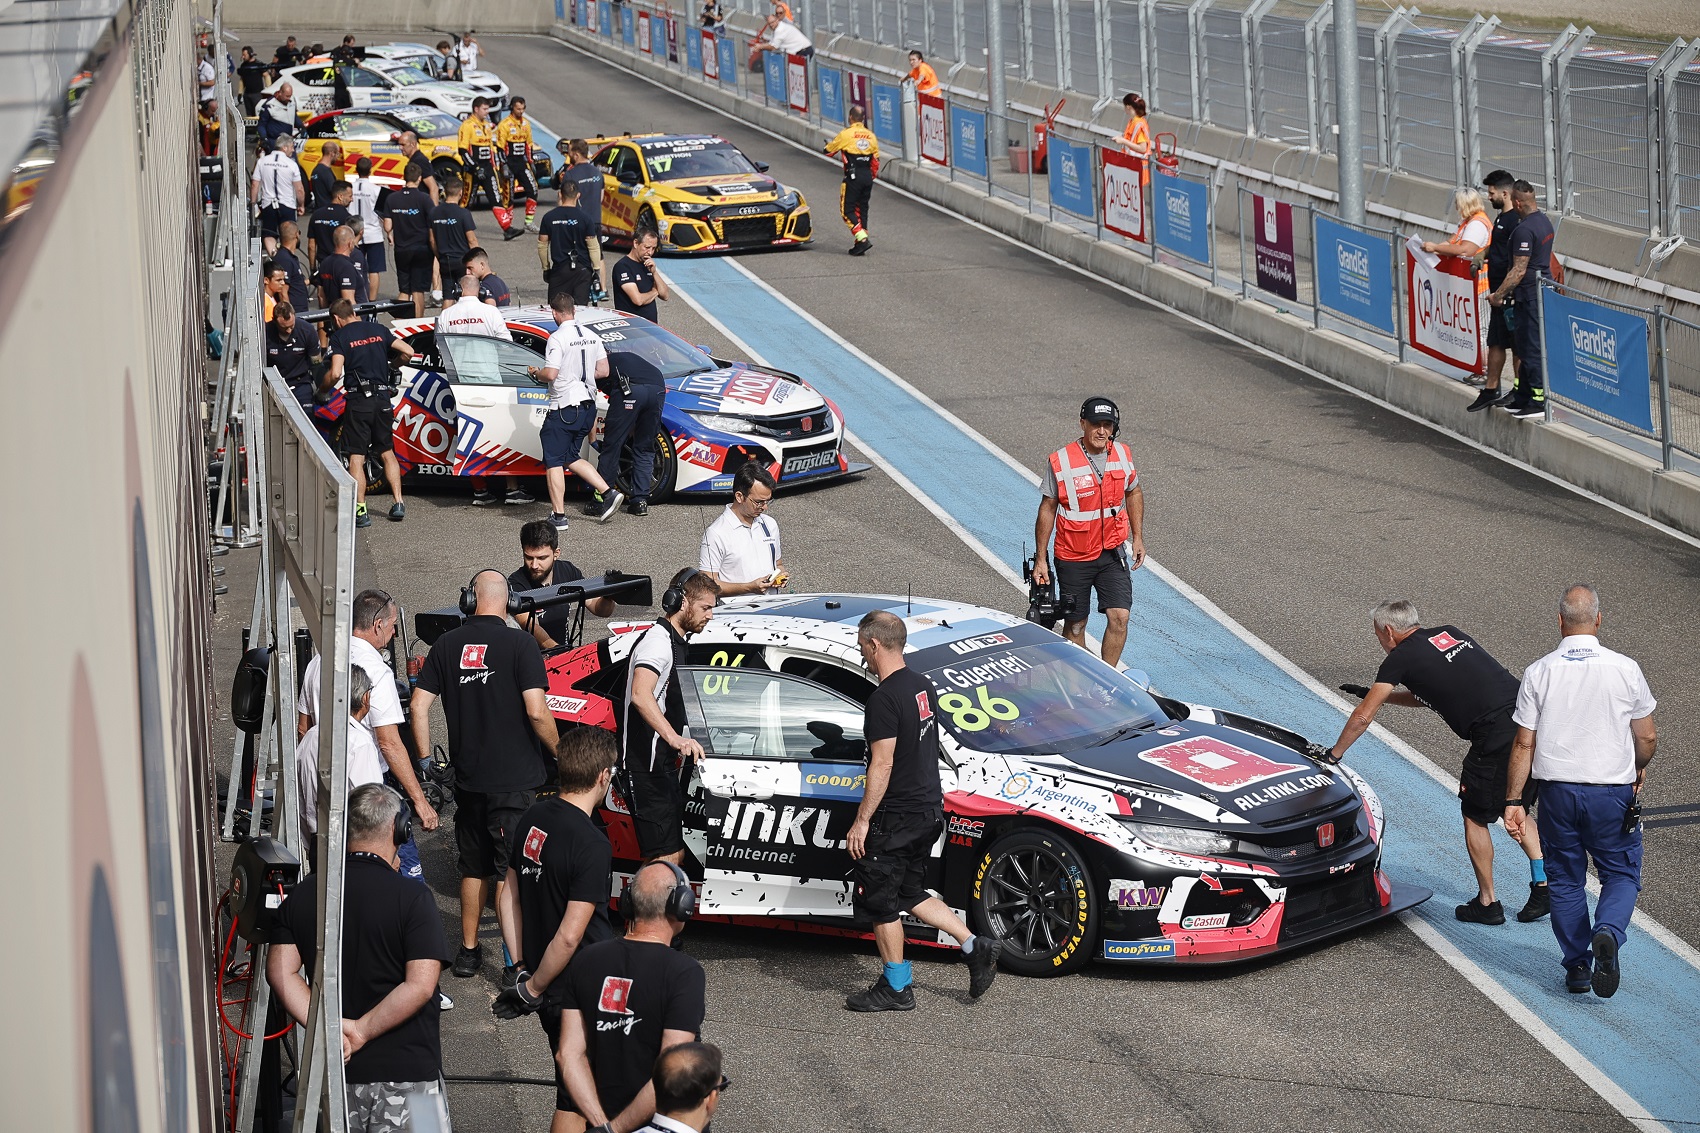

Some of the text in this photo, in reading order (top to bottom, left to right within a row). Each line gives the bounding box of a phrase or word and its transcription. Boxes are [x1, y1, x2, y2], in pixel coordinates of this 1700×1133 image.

[648, 157, 673, 174] 17
[602, 189, 634, 227] DHL
[1434, 288, 1472, 334] ALSACE
[449, 318, 484, 327] HONDA
[350, 335, 383, 348] HONDA
[423, 354, 433, 367] A.
[692, 447, 721, 464] KW
[783, 448, 836, 475] Engstler
[949, 632, 1014, 655] WTCR
[943, 651, 1033, 689] Guerrieri
[547, 697, 582, 711] Castrol
[938, 684, 1020, 731] 86
[1031, 785, 1098, 813] Argentina
[949, 816, 986, 835] HRC
[950, 834, 973, 847] JAS
[729, 845, 796, 865] Internet
[973, 852, 992, 900] EAGLE
[1117, 886, 1166, 908] KW
[1193, 916, 1226, 928] Castrol
[1107, 944, 1172, 956] GOODYEAR
